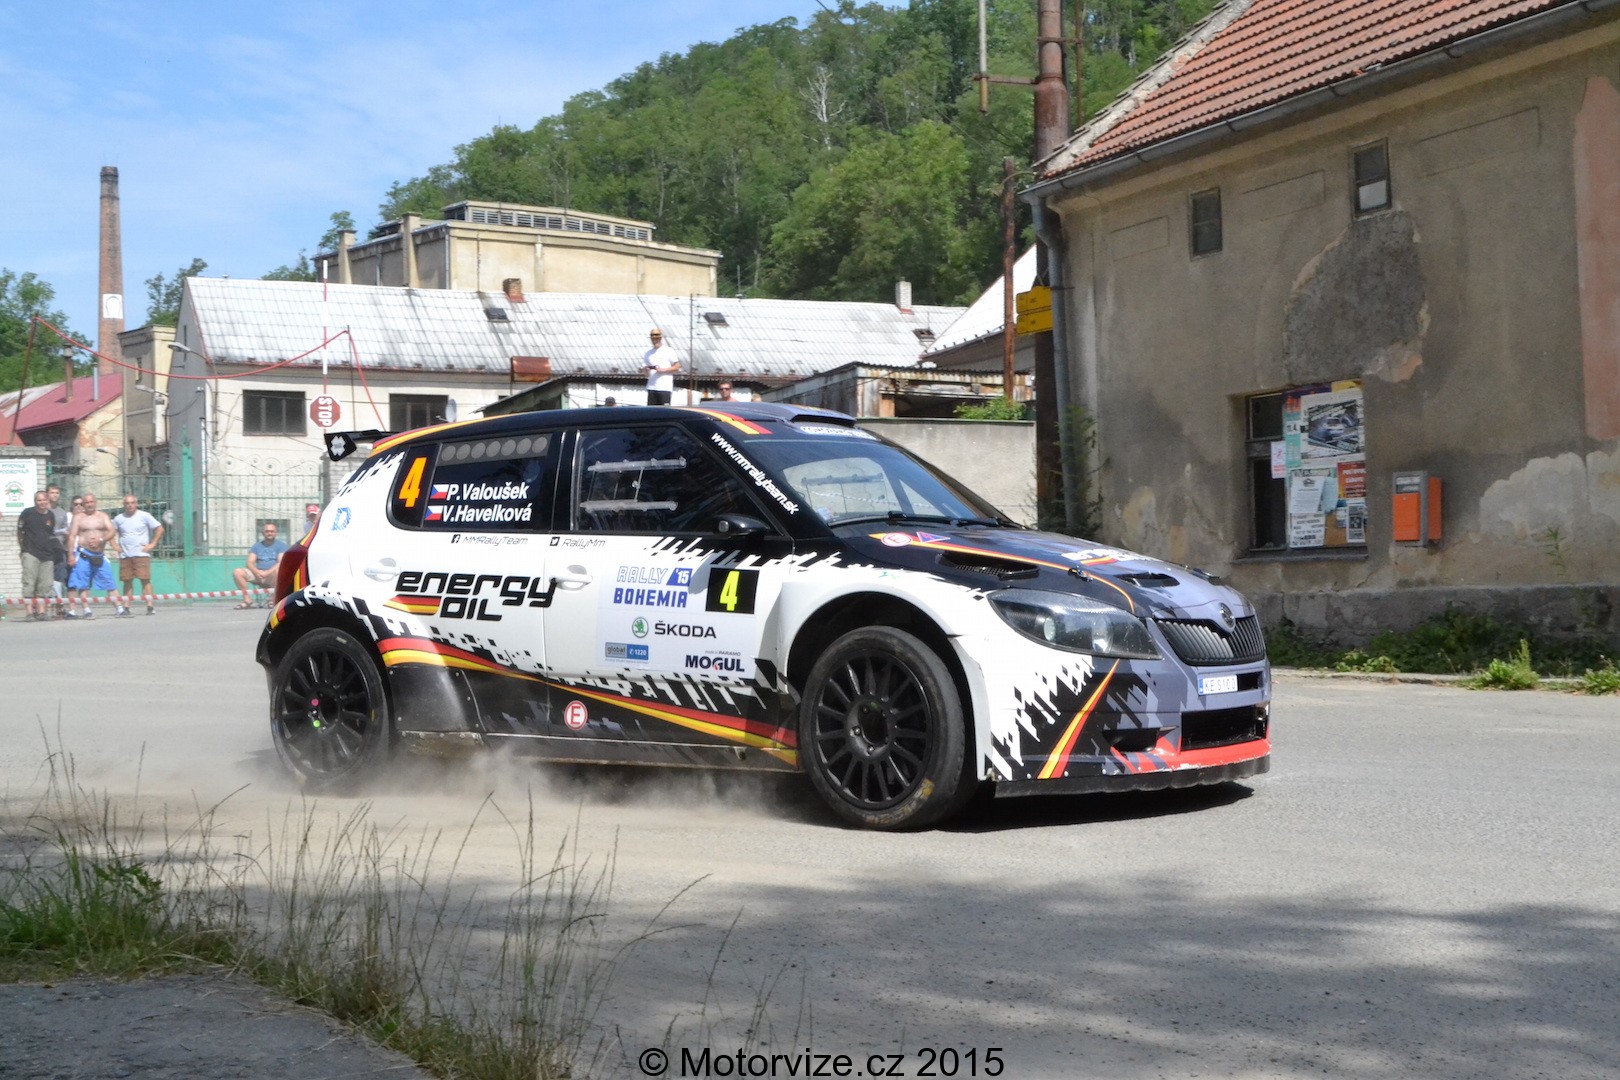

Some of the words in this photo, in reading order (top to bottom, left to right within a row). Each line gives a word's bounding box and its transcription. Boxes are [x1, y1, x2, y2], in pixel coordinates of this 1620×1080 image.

[318, 397, 332, 427] STOP
[399, 457, 428, 508] 4
[710, 432, 800, 515] www.mmrallyteam.sk
[446, 482, 530, 501] P.Valoušek
[442, 503, 533, 522] V.Havelková
[462, 536, 529, 547] MMRallyTeam
[562, 538, 606, 549] RallyMm
[616, 566, 669, 585] RALLY
[395, 571, 558, 608] energy
[613, 587, 688, 608] BOHEMIA
[719, 570, 740, 611] 4
[439, 596, 503, 622] OIL
[654, 620, 717, 639] ŠKODA
[685, 654, 745, 673] MOGUL
[571, 705, 581, 724] E
